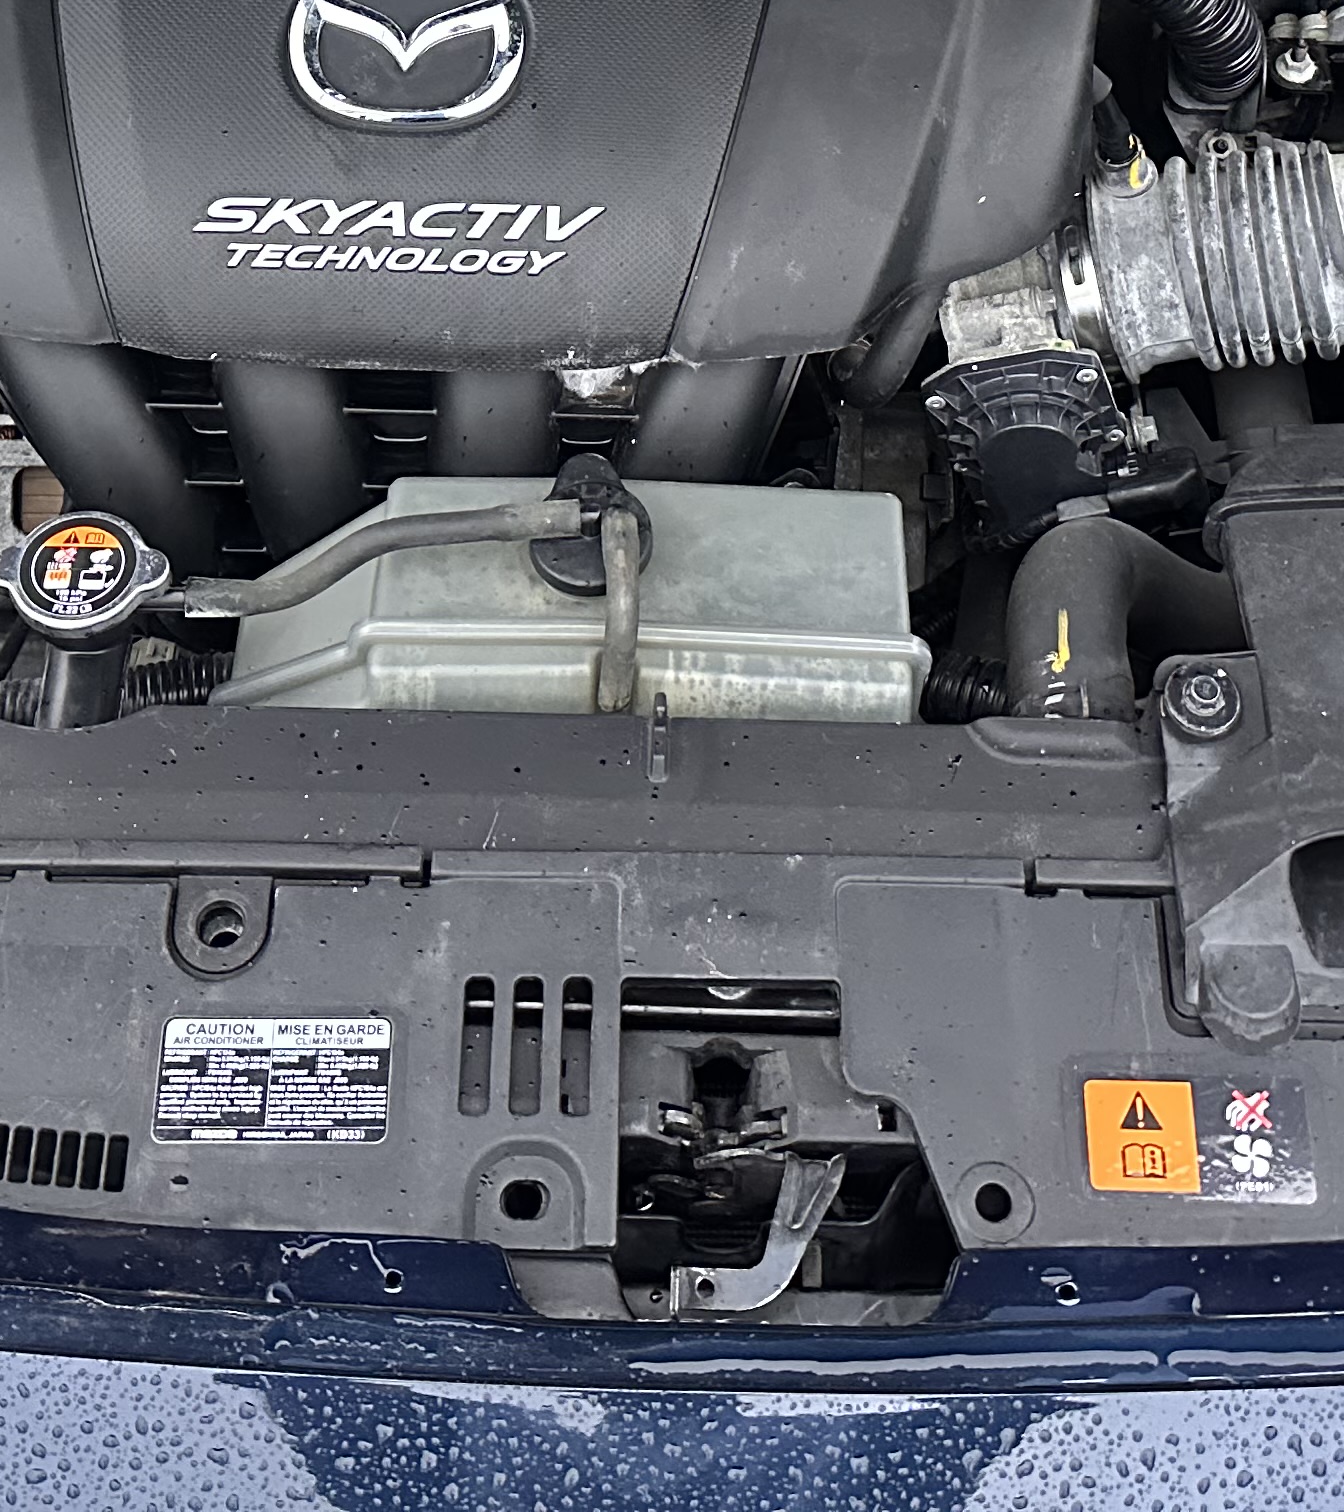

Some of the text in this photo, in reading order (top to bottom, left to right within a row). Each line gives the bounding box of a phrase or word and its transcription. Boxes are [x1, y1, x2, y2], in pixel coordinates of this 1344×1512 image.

[192, 196, 606, 241] SKYACTIV
[226, 242, 567, 276] TECHNOLOGY
[186, 1023, 255, 1035] CAUTION
[277, 1024, 385, 1036] MISE EN GARDE
[173, 1036, 264, 1045] AIR CONDITIONER
[295, 1037, 364, 1046] CLIMATISEUR
